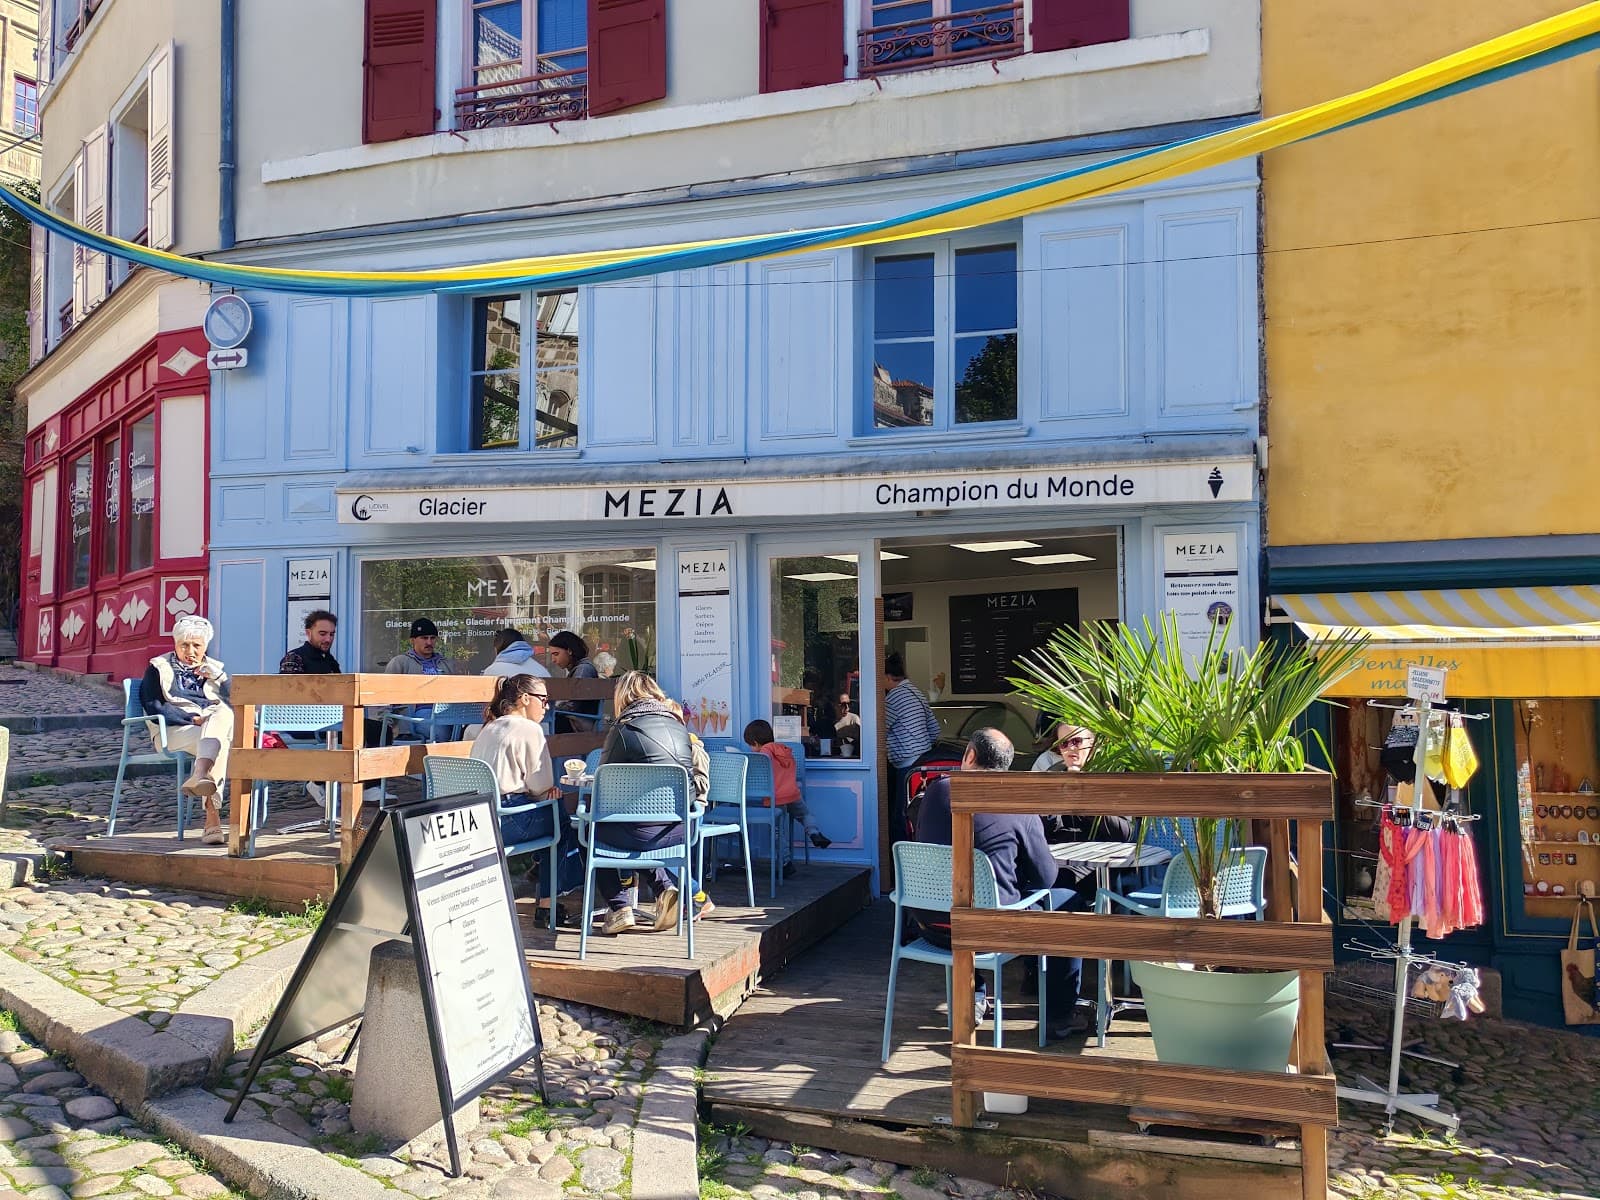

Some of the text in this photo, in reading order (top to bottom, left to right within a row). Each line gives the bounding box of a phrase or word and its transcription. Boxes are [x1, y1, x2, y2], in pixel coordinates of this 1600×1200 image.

[419, 497, 487, 517] Glacier
[604, 487, 734, 518] MEZIA
[875, 480, 999, 507] Champion
[1006, 478, 1039, 499] du
[1047, 474, 1135, 498] Monde
[1176, 544, 1225, 556] MEZIA
[291, 570, 328, 580] MEZIA
[681, 562, 726, 574] MEZIA
[467, 578, 542, 598] MEZIA
[987, 594, 1037, 608] MEZIA
[385, 619, 412, 628] Glaces
[465, 617, 494, 626] Glacier
[587, 614, 599, 623] du
[600, 613, 630, 623] monde
[420, 809, 479, 844] MEZIA
